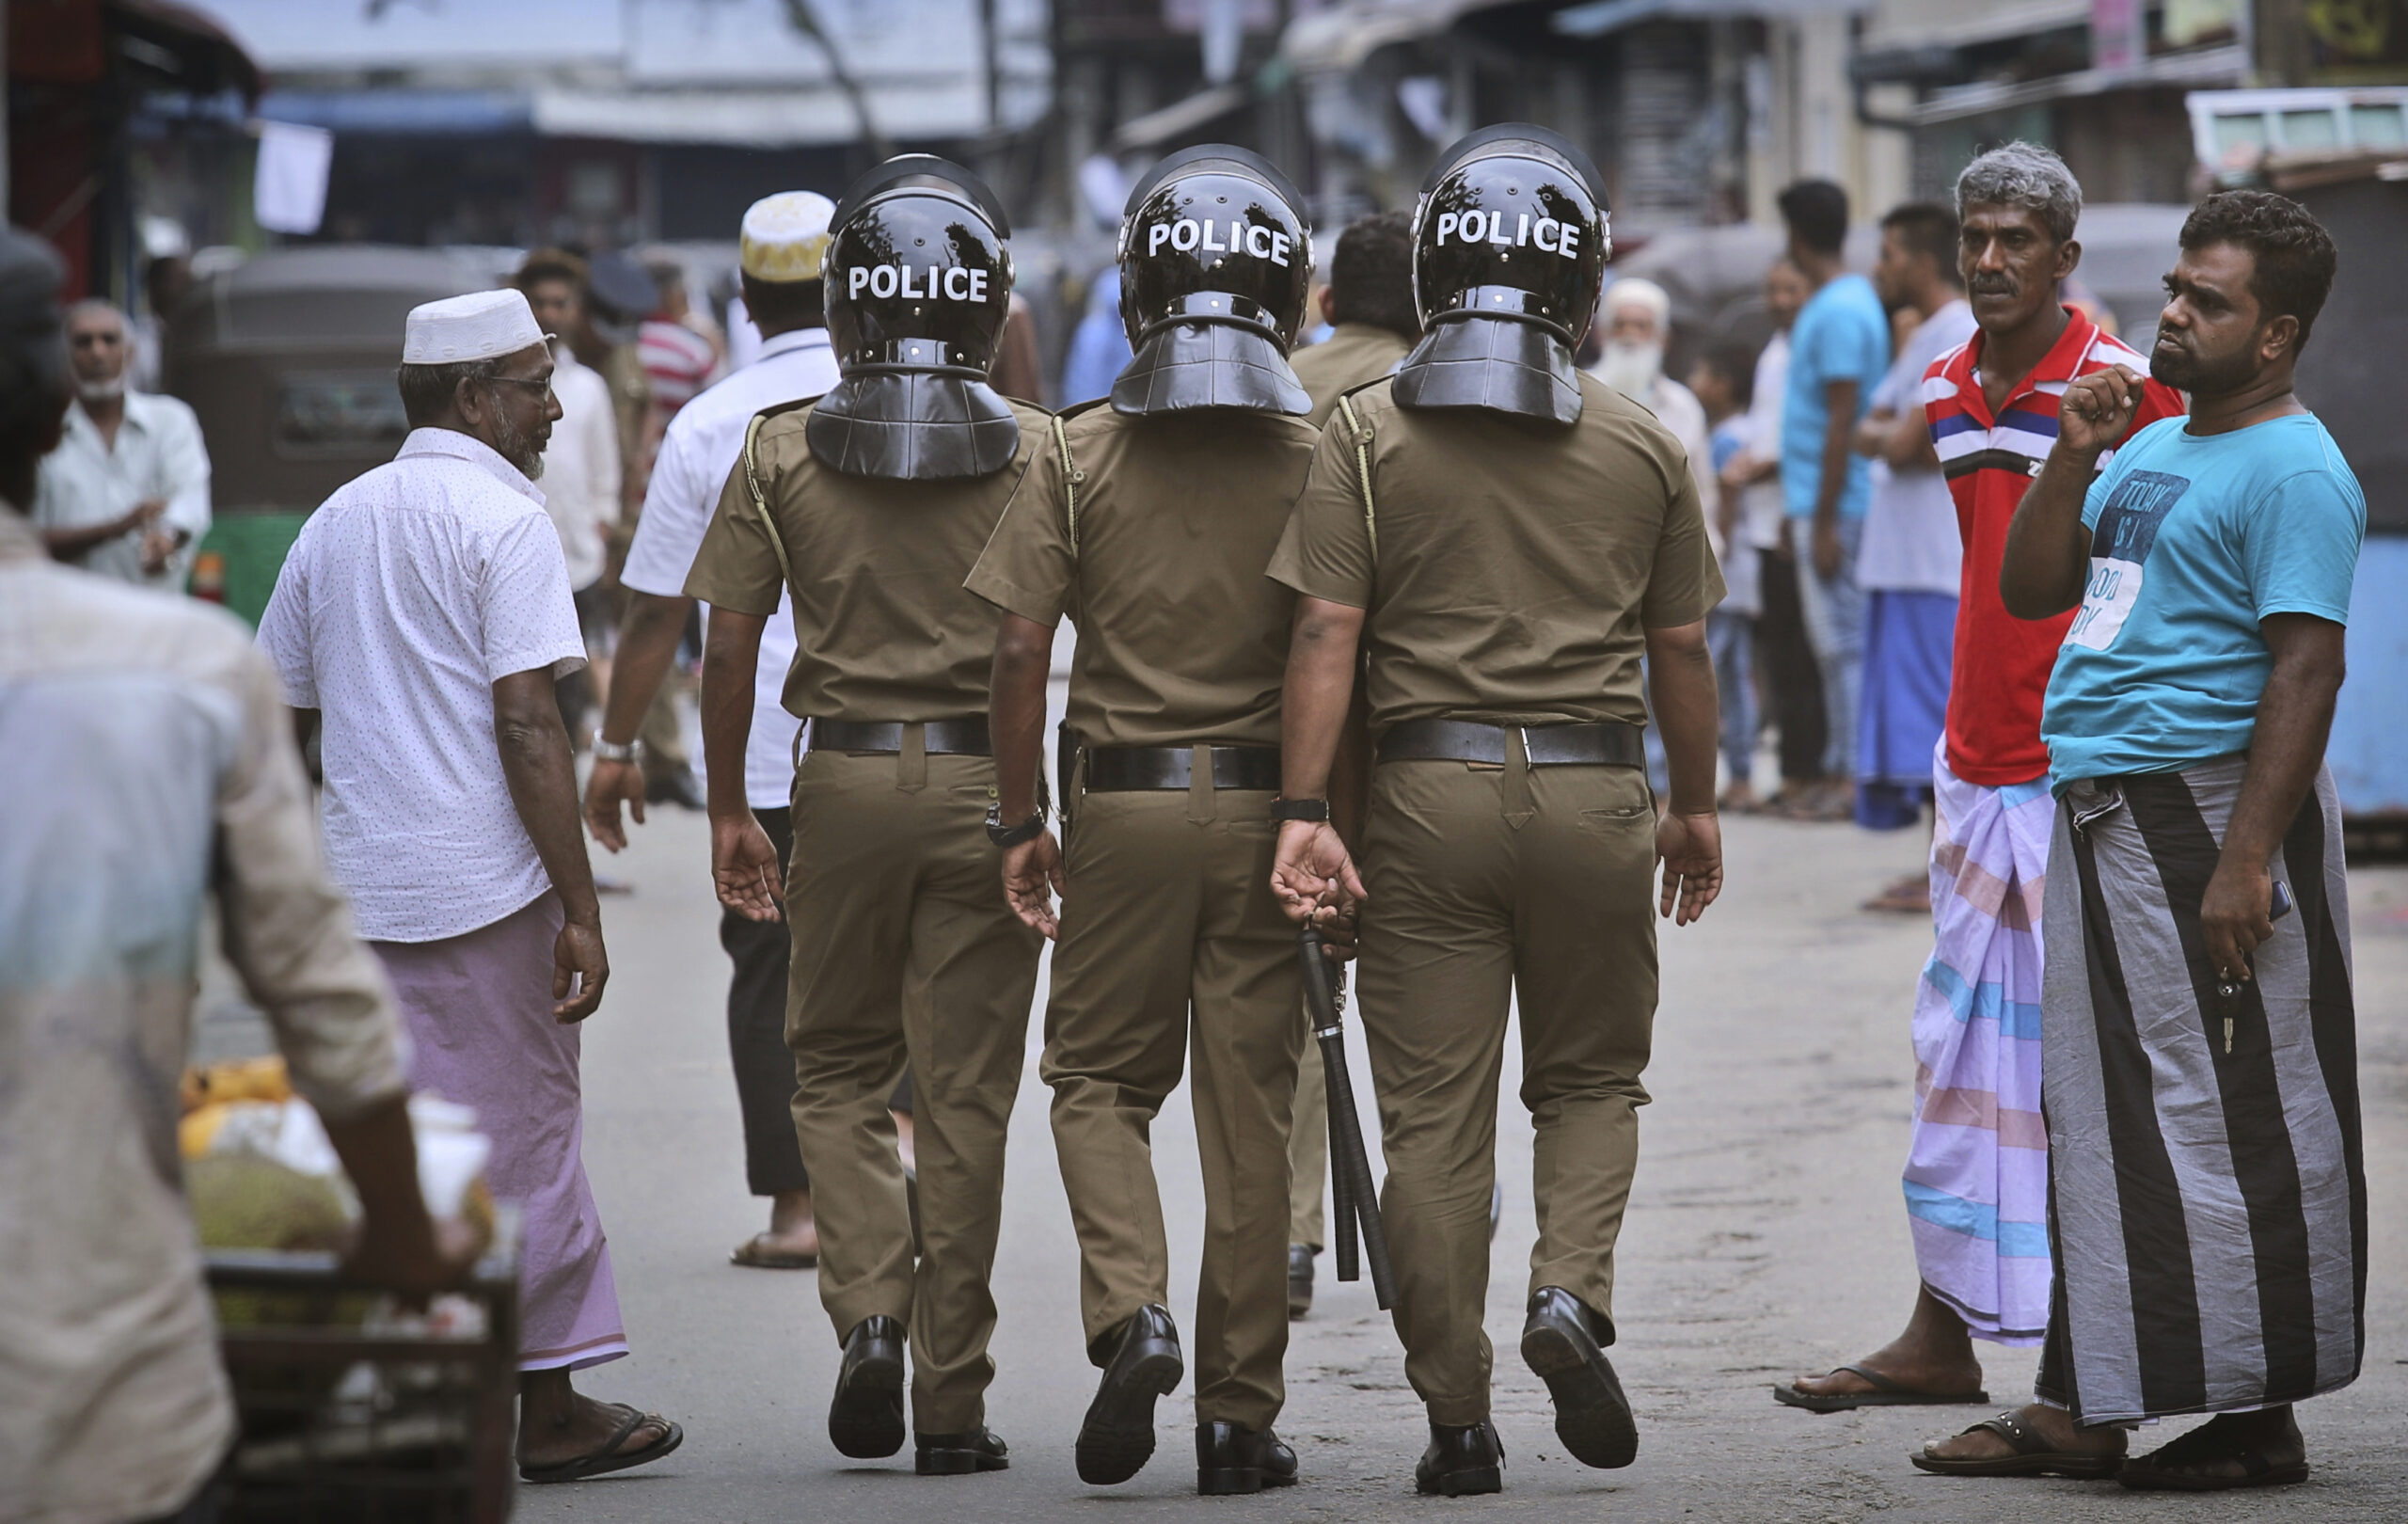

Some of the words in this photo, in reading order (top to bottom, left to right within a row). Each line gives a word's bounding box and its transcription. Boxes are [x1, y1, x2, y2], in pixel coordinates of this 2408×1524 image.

[1149, 218, 1291, 268] POLICE
[1436, 209, 1580, 260] POLICE
[848, 264, 988, 303] POLICE
[2116, 480, 2172, 513] TODAY
